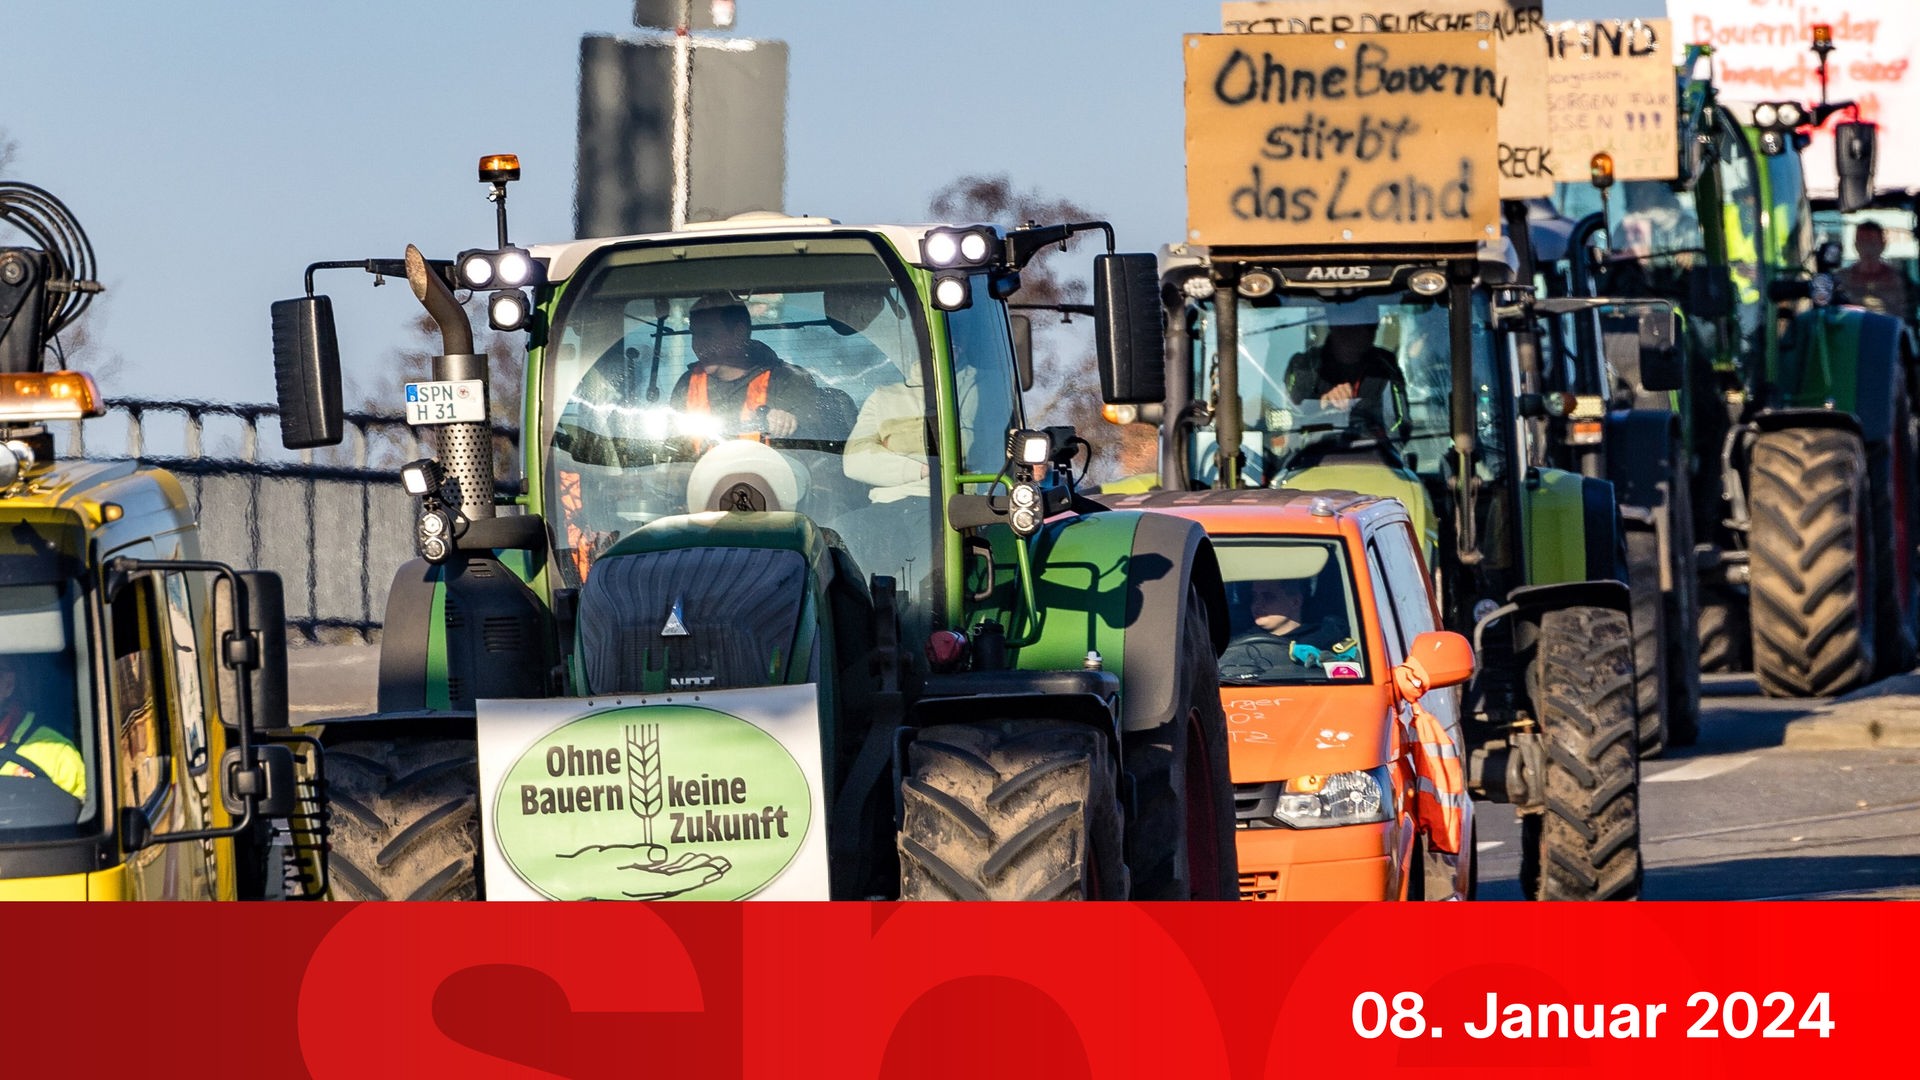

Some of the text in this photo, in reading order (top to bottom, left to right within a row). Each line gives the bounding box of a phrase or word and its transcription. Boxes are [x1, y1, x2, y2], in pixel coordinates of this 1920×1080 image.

[1214, 49, 1347, 106] Ohne
[1261, 112, 1420, 161] stirbt
[1231, 157, 1471, 222] das Land
[1305, 266, 1371, 280] AXOS
[419, 385, 453, 402] SPN
[417, 403, 456, 420] H 31
[546, 745, 621, 777] Ohne
[521, 783, 624, 815] Bauern
[667, 773, 746, 807] keine
[669, 805, 789, 844] Zukunft
